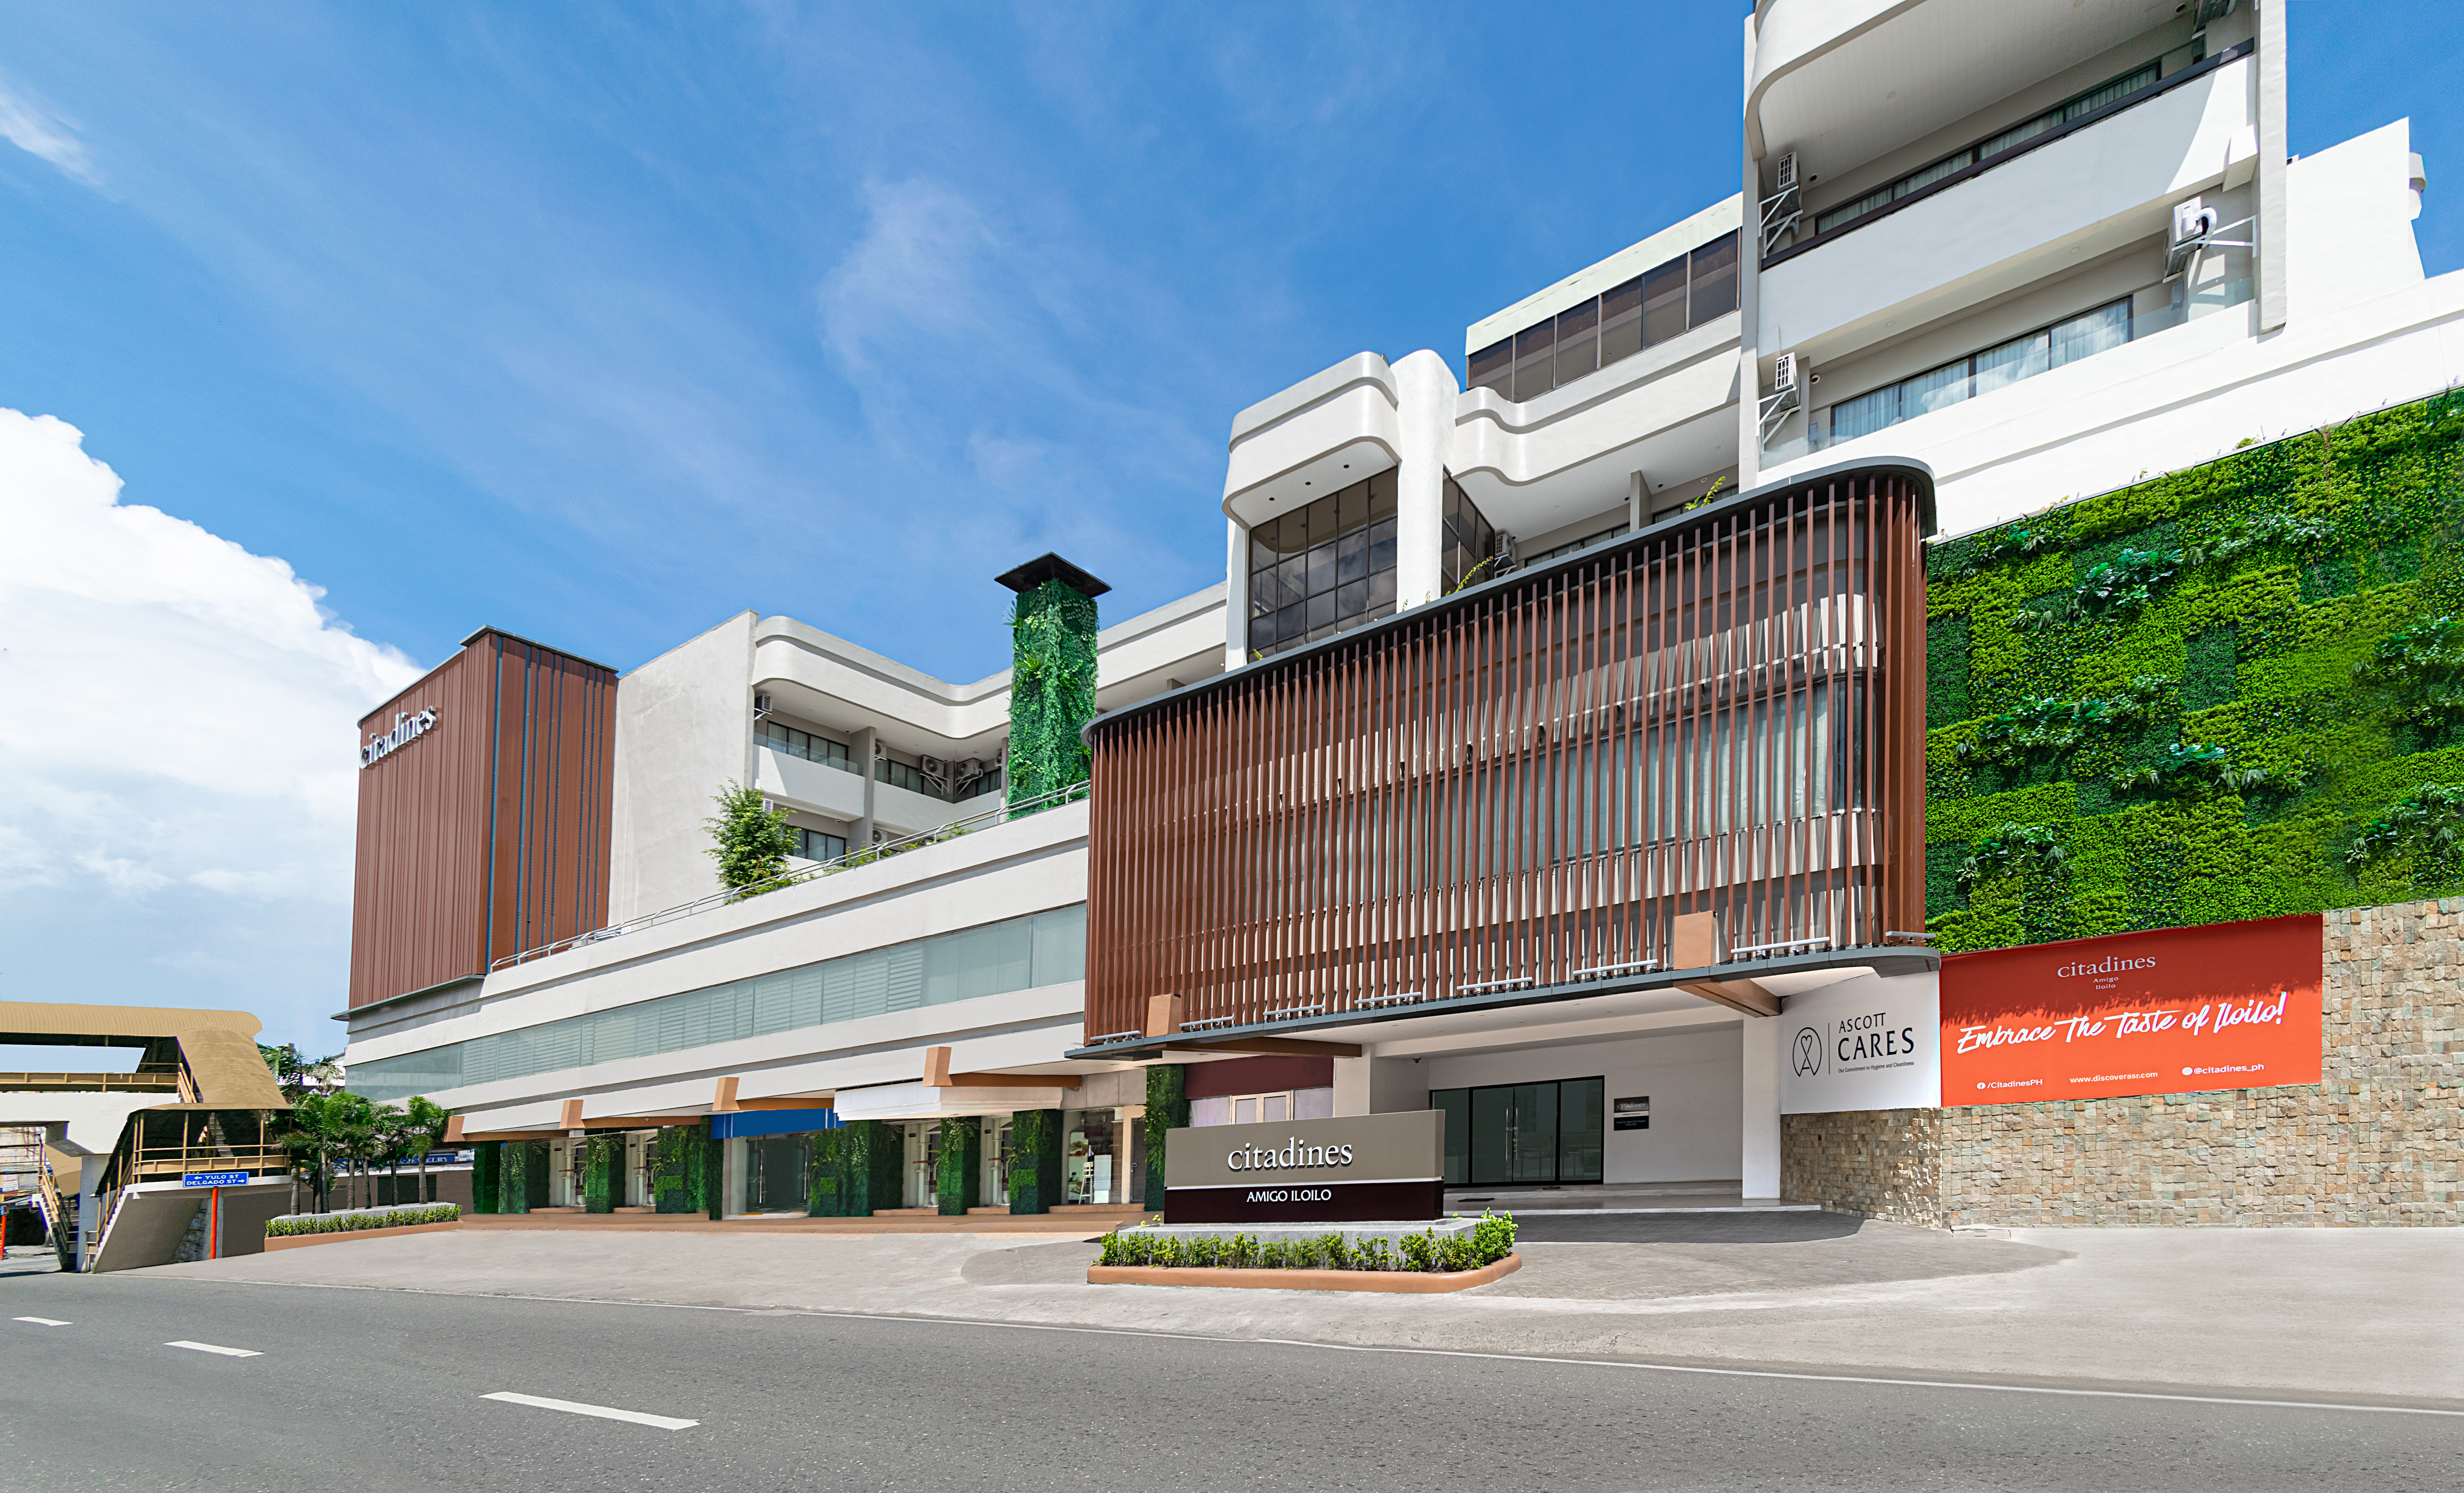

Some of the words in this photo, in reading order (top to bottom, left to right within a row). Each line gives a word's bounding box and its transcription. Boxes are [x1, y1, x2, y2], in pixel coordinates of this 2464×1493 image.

[360, 706, 436, 769] citadines
[2057, 956, 2156, 977] citadines
[1839, 1012, 1886, 1033] ASCOTT
[1957, 1025, 2056, 1054] Embrace
[2054, 1016, 2106, 1043] The
[2104, 1010, 2183, 1038] Taste
[2182, 1004, 2211, 1036] of
[2213, 991, 2287, 1033] Iloilo!
[1838, 1027, 1915, 1061] CARES
[2070, 1072, 2158, 1083] www.discoverasr.com
[2194, 1064, 2265, 1074] @citadines_ph
[1227, 1136, 1353, 1170] citadines
[1246, 1190, 1288, 1202] AMIGO
[1291, 1189, 1332, 1201] ILOILO
